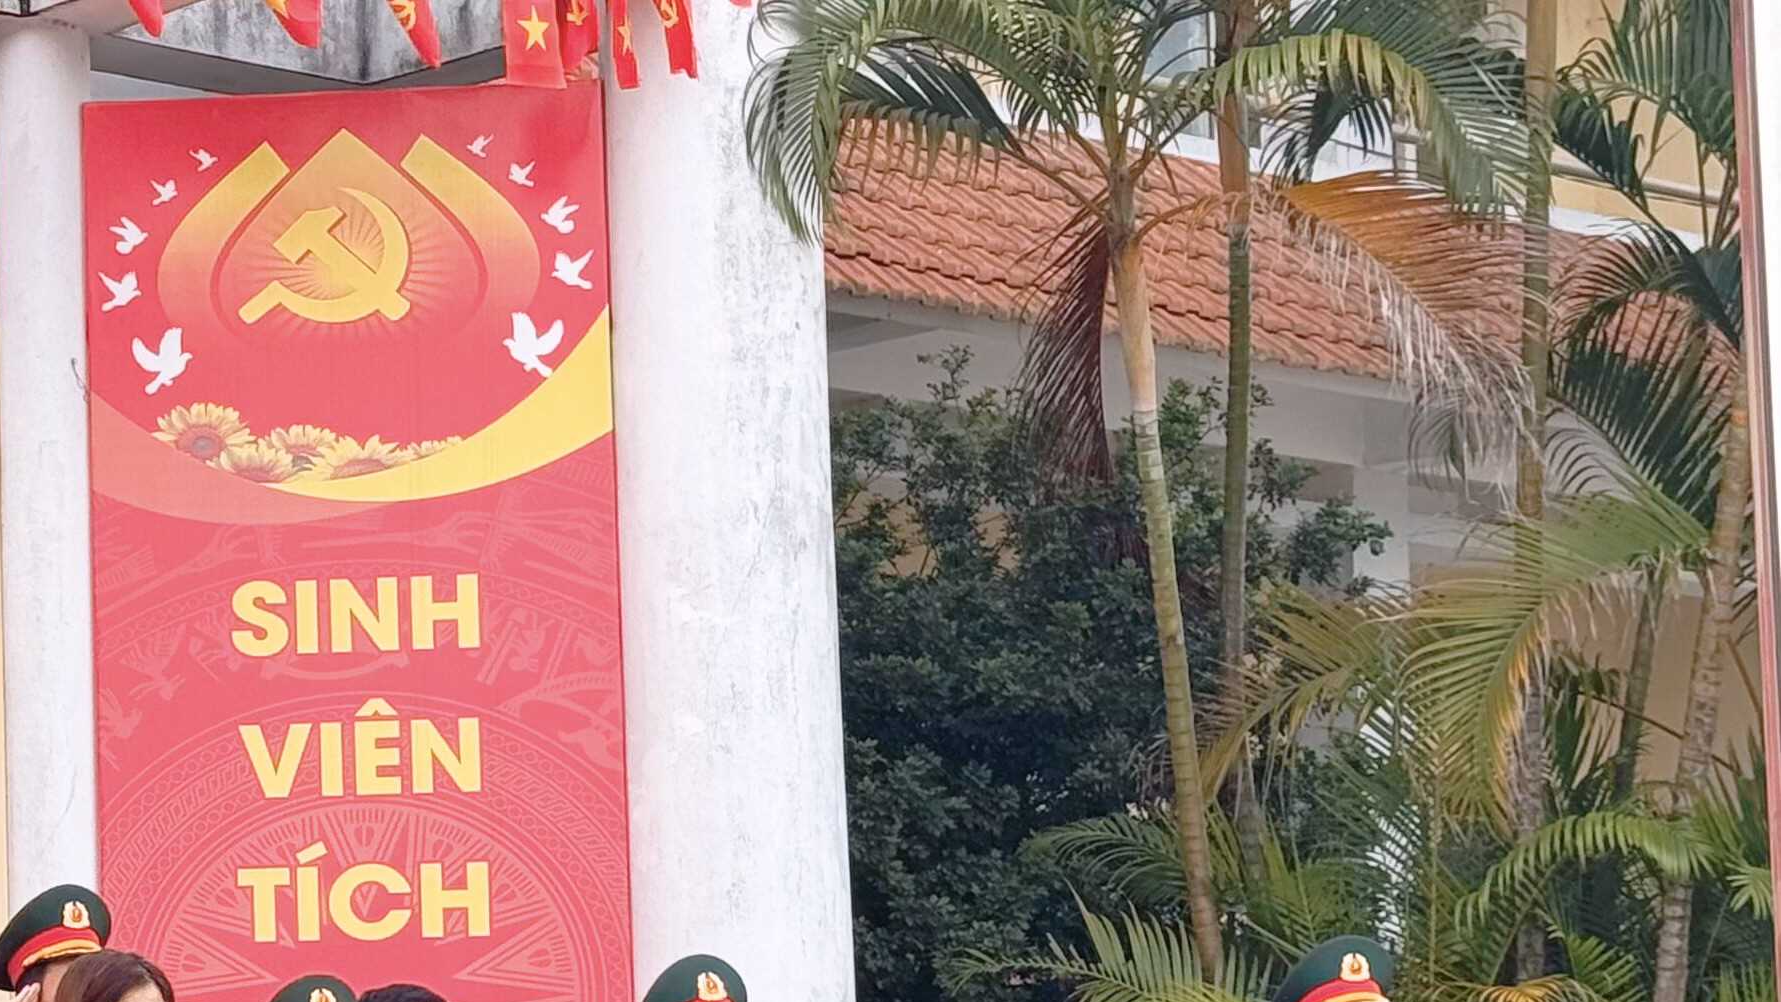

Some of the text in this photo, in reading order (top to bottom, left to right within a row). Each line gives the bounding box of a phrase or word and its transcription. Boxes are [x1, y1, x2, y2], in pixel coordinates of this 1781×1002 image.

[230, 572, 482, 658] SINH
[237, 697, 482, 799] VIÊN
[236, 840, 491, 943] TÍCH
